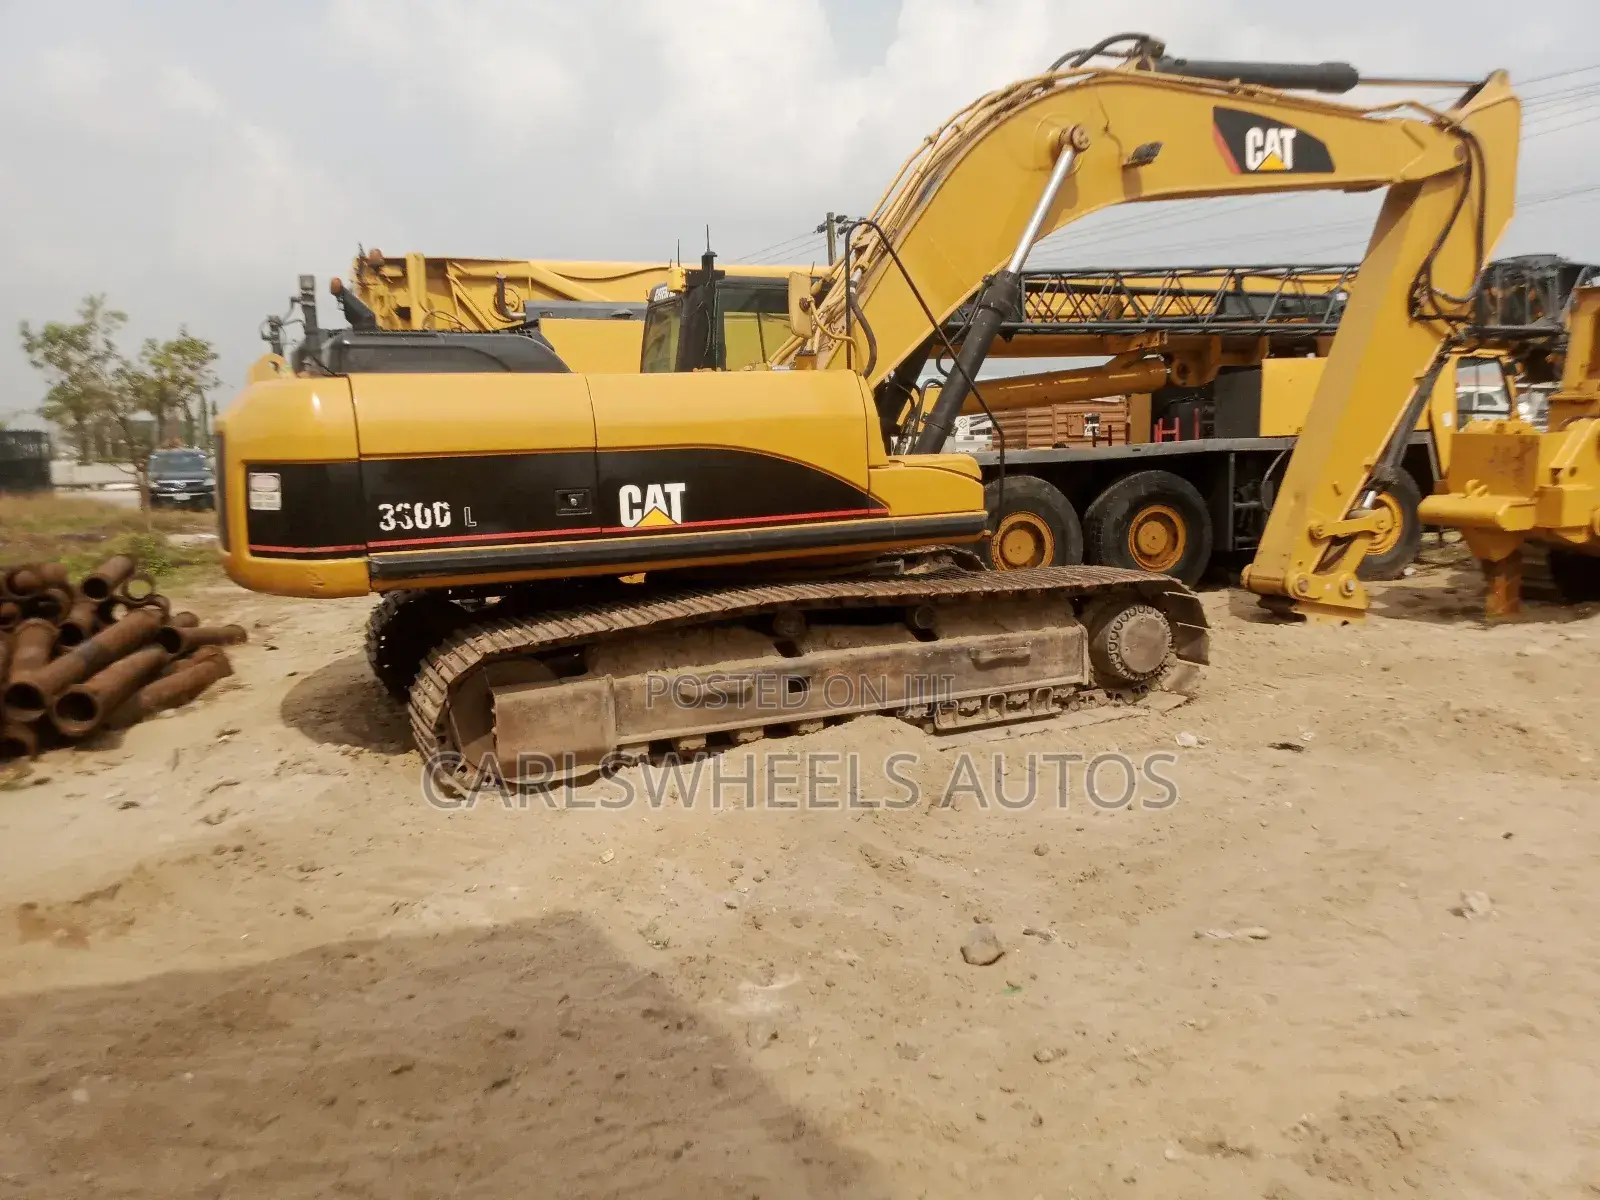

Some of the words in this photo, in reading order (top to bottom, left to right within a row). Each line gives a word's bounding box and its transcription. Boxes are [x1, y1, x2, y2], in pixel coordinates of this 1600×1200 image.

[1245, 127, 1297, 171] CAT
[463, 506, 478, 528] L
[619, 483, 686, 528] CAT
